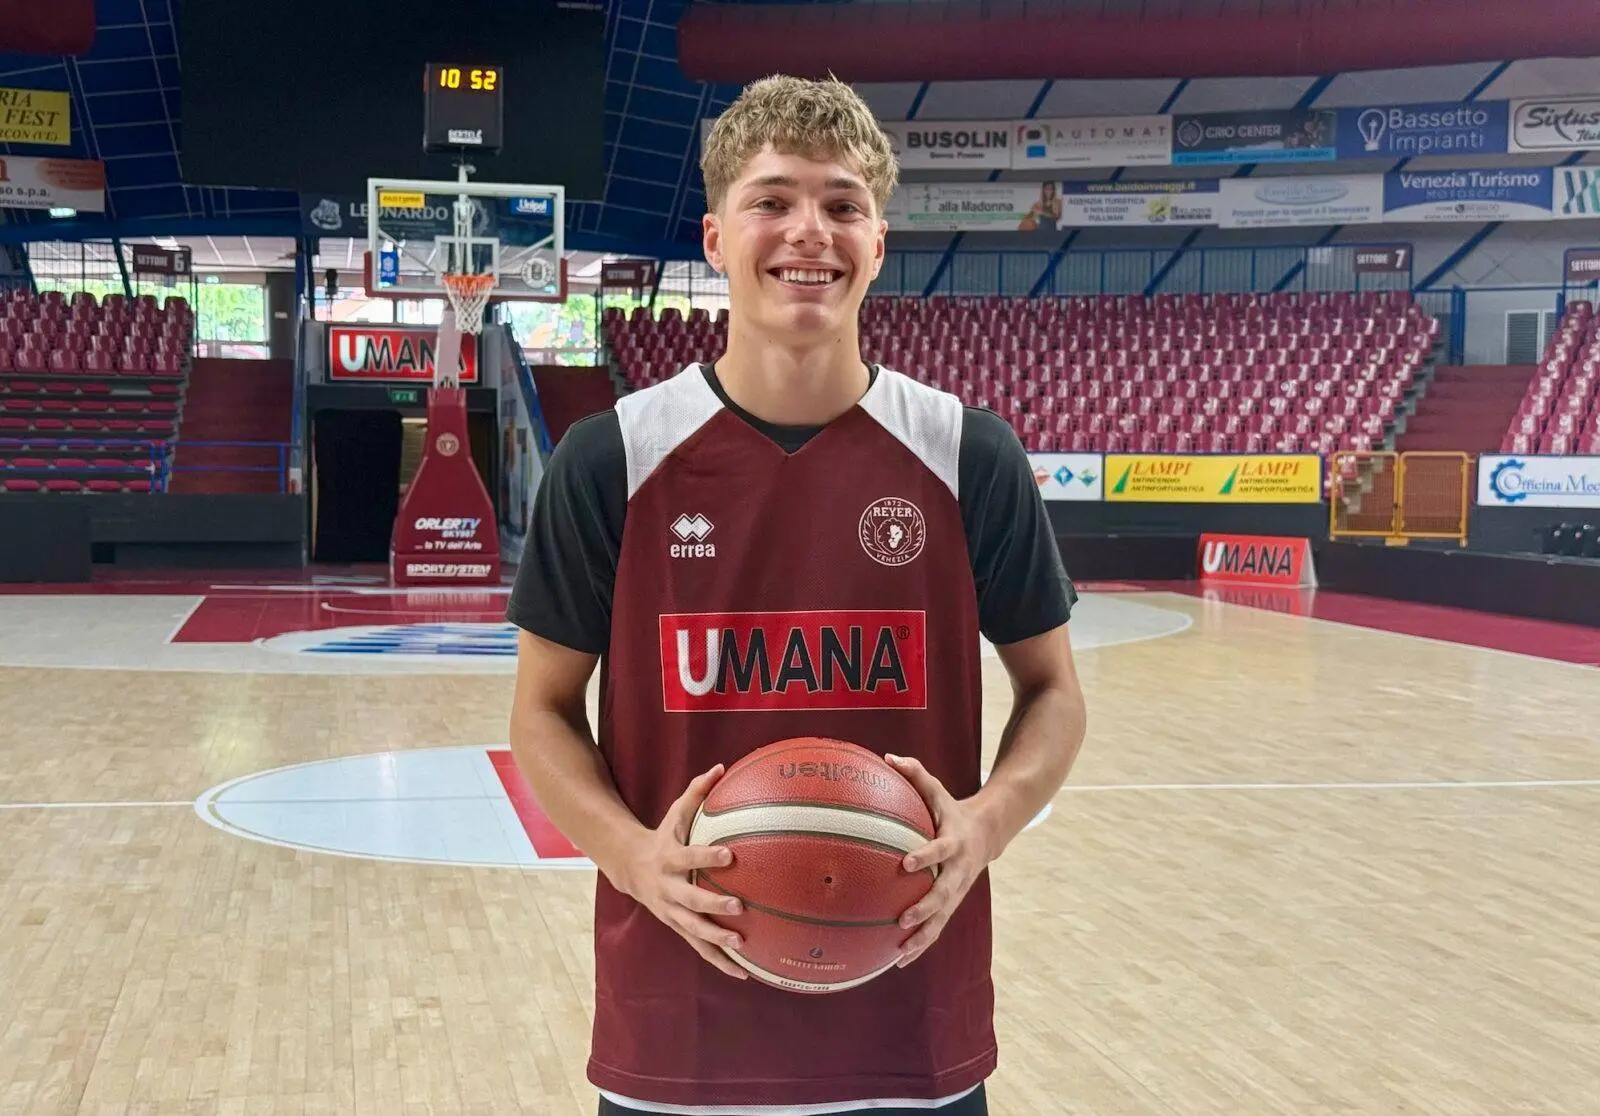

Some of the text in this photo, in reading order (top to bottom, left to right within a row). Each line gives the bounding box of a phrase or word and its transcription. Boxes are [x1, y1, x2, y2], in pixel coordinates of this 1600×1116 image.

[440, 68, 497, 91] 10 52
[5, 109, 60, 127] FEST
[1388, 108, 1488, 129] Bassetto
[906, 131, 1008, 148] BUSOLIN
[1055, 126, 1168, 140] AUTOMAT
[1237, 124, 1281, 137] CENTER
[1388, 131, 1485, 152] Impianti
[1400, 171, 1541, 189] Venezia Turismo
[938, 200, 1014, 213] alla Madonna
[174, 252, 185, 272] 6
[1356, 250, 1406, 269] SETTORE 7
[641, 265, 651, 285] 7
[1133, 461, 1193, 476] LAMPI
[1240, 461, 1301, 477] LAMPI
[1497, 470, 1561, 492] Officina
[873, 507, 913, 518] REYER
[415, 518, 481, 531] ORLERTV
[435, 541, 446, 550] TV
[876, 552, 911, 563] VENEZIA
[1202, 541, 1292, 576] UMANA
[778, 761, 890, 791] molten
